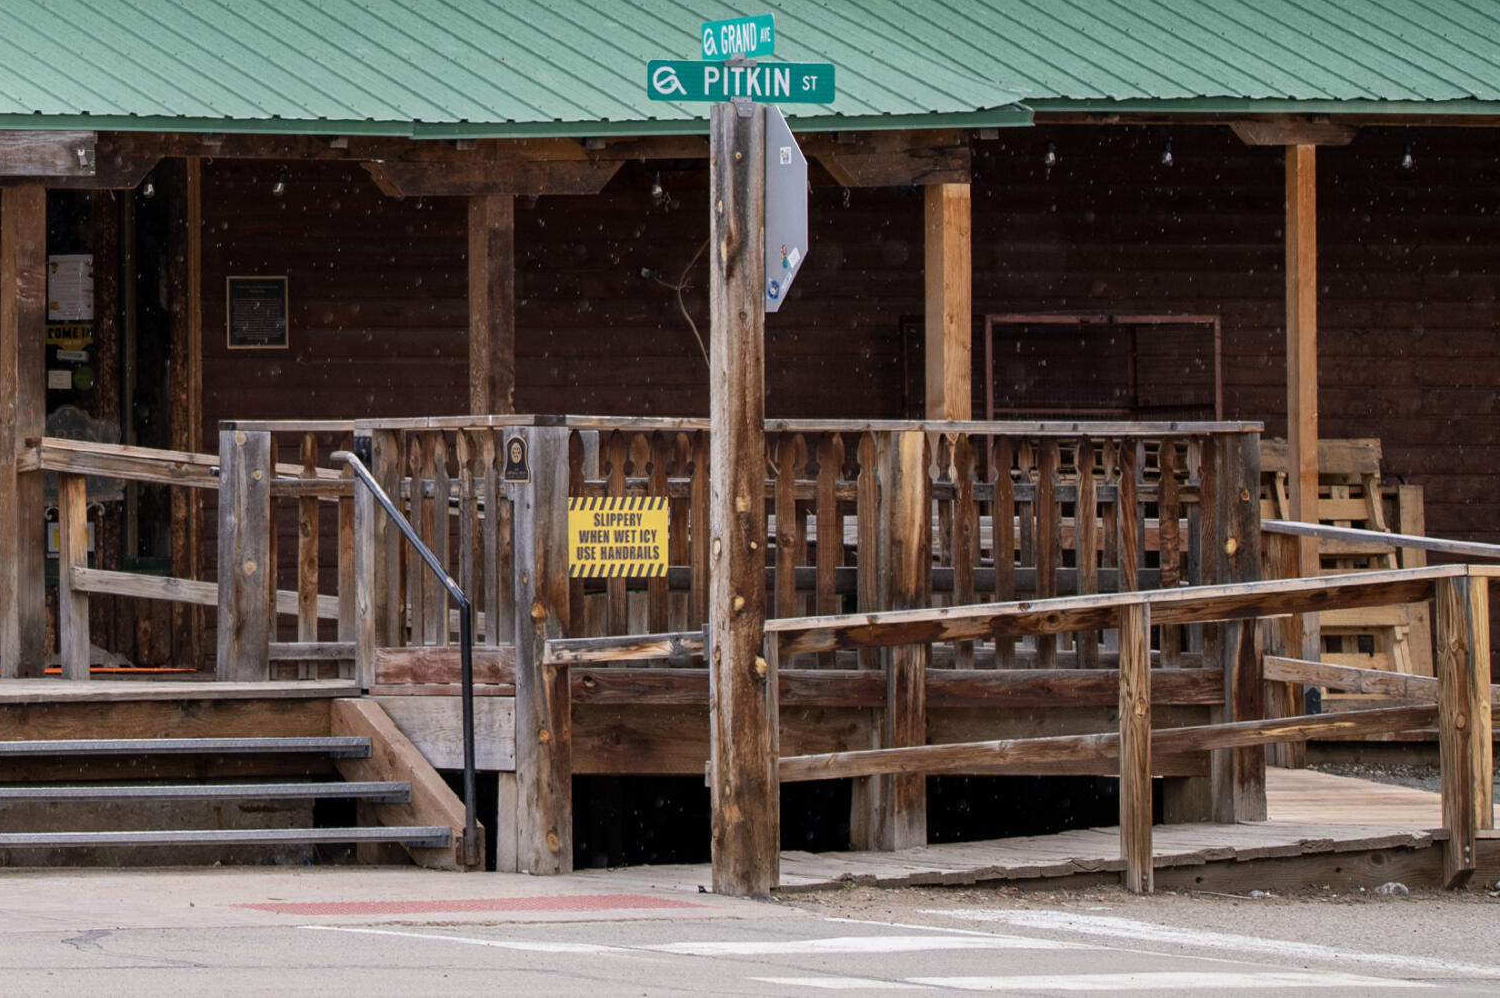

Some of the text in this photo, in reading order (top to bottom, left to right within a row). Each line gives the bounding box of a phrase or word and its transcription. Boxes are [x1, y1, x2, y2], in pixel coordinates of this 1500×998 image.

[720, 22, 757, 55] GRAND
[760, 27, 771, 43] AVE
[703, 66, 790, 97] PITKIN
[802, 75, 818, 91] ST
[48, 328, 78, 339] COME
[593, 512, 643, 527] SLIPPERY
[579, 529, 658, 544] WHEN WET ICY
[577, 546, 660, 560] USE HANDRAILS
